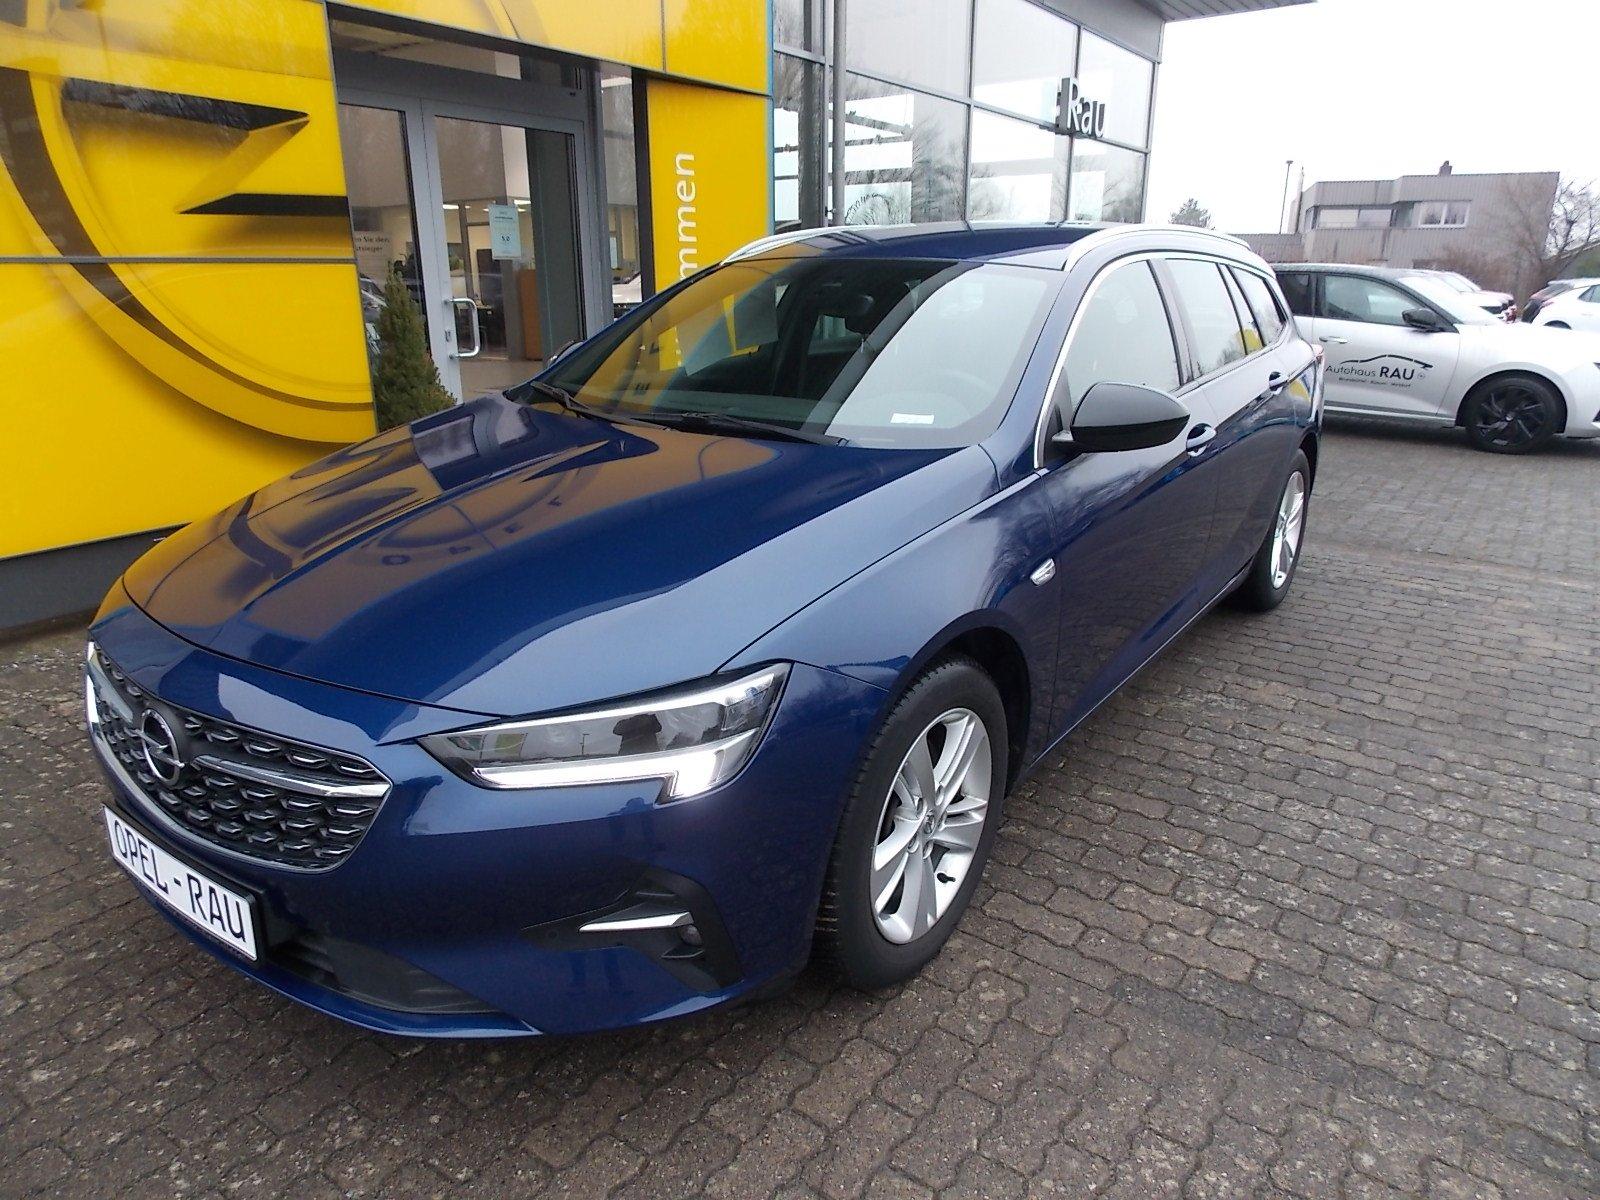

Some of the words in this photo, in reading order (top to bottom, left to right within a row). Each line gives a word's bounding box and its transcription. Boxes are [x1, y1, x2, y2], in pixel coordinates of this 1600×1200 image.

[1062, 77, 1105, 138] Rau
[1325, 365, 1376, 377] Autohaus
[1379, 366, 1415, 380] RAU
[114, 820, 169, 894] OPEL
[187, 873, 246, 942] RAU
